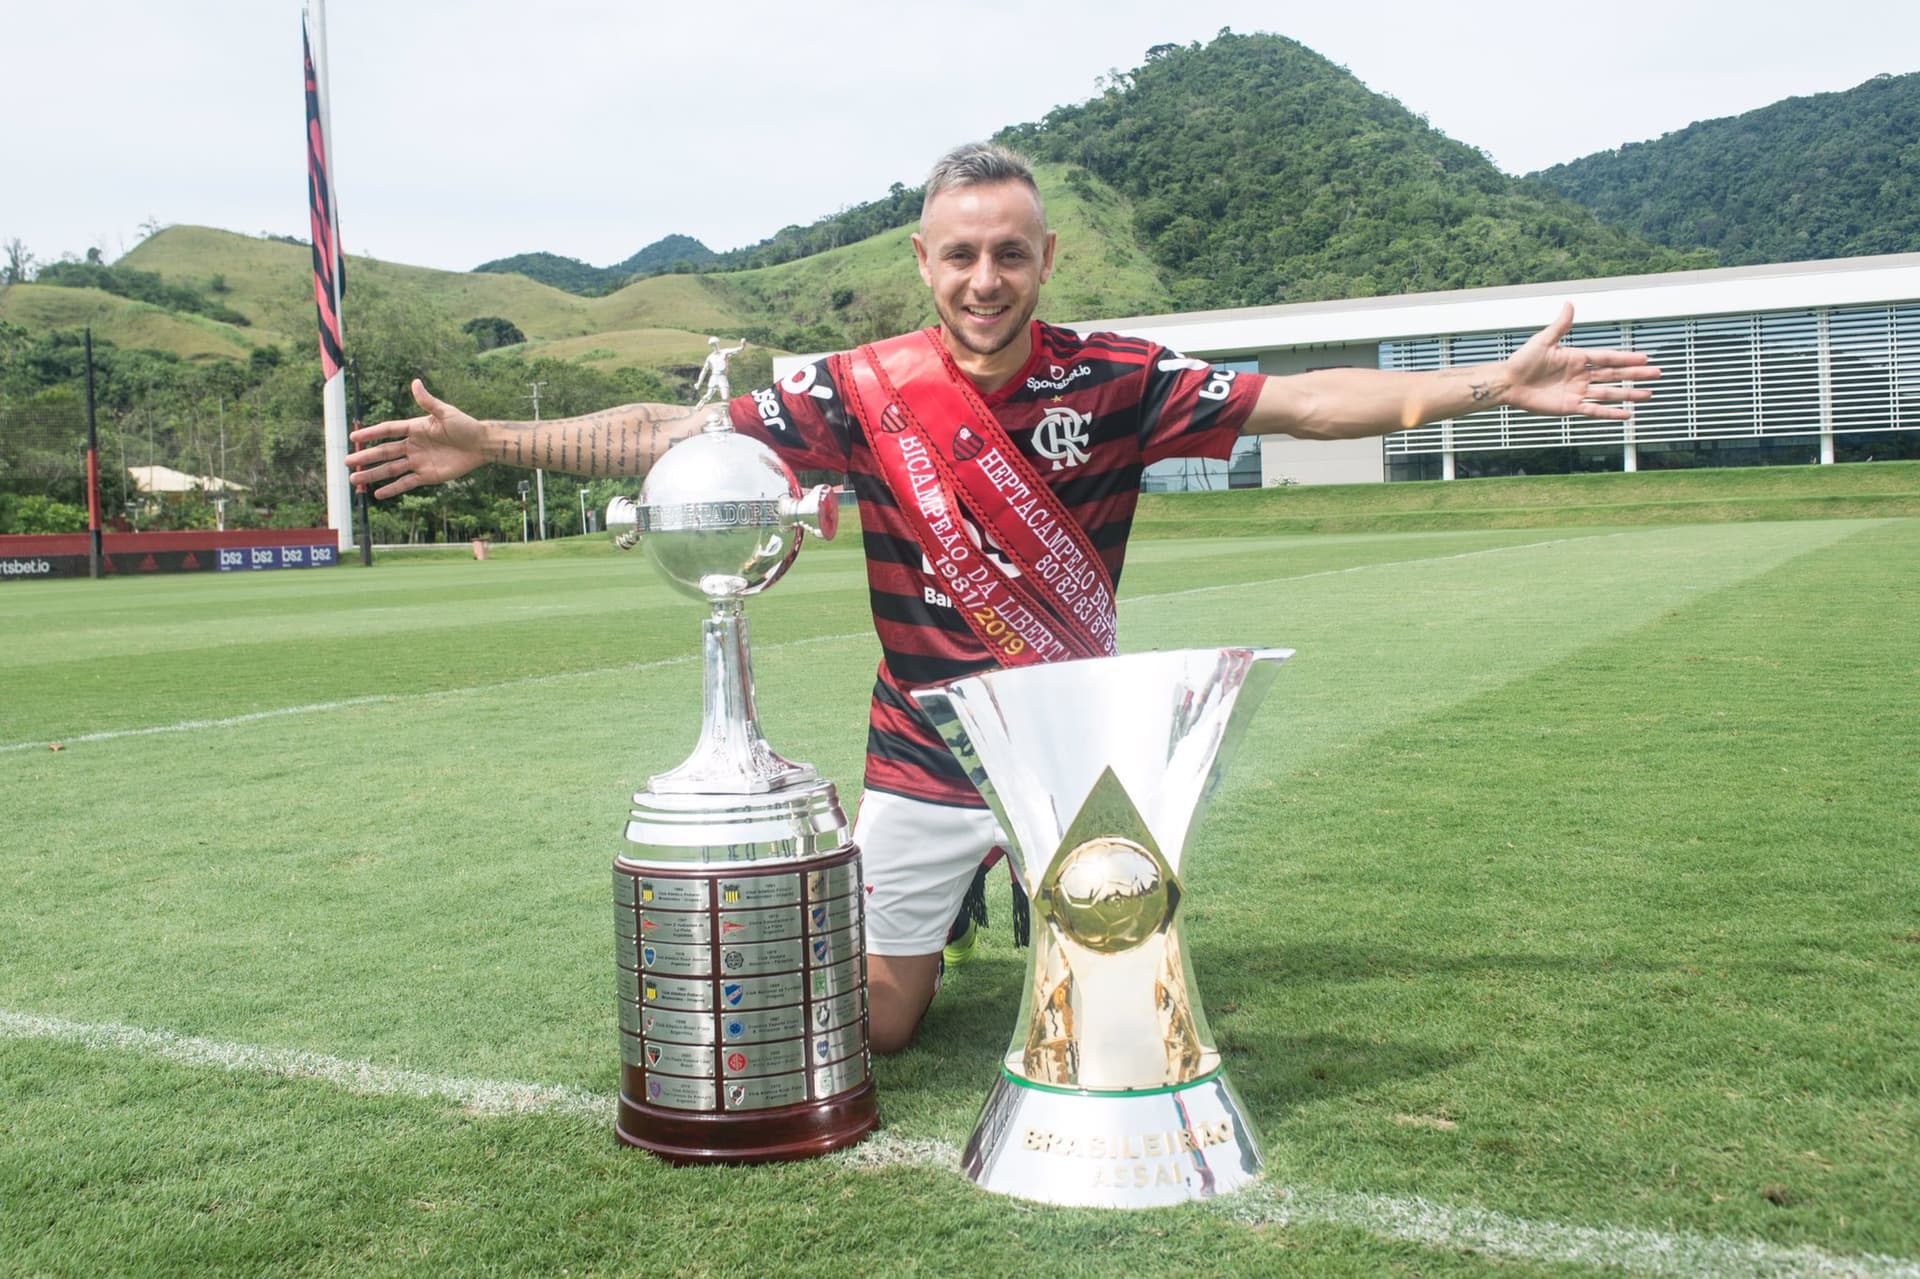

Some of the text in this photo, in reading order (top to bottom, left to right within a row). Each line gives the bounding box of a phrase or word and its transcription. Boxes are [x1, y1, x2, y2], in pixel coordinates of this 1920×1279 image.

[220, 548, 243, 566] bs2
[251, 547, 273, 564] bs2
[281, 545, 303, 563] bs2
[310, 544, 332, 561] bs2
[967, 564, 999, 600] DA
